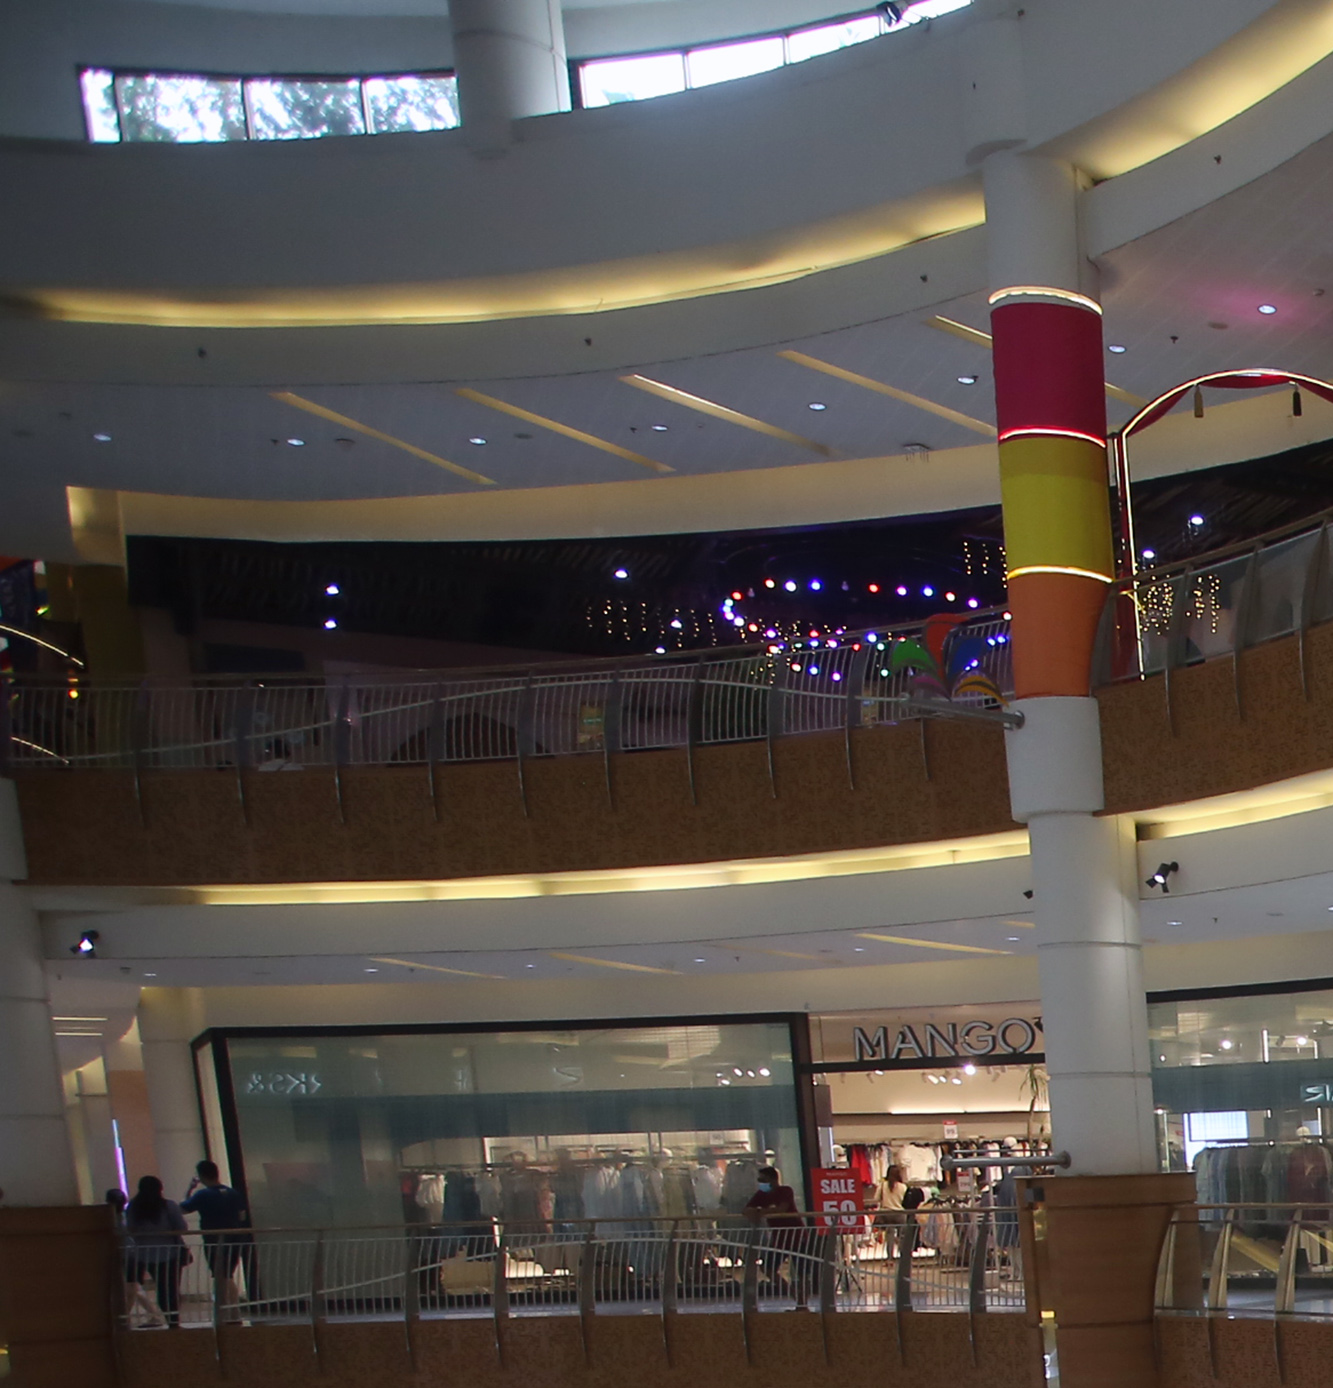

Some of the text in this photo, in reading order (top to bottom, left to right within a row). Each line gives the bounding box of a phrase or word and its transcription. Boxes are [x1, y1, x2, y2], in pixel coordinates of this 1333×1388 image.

[854, 1018, 1036, 1061] MANGO
[820, 1179, 856, 1194] SALE
[823, 1200, 857, 1226] 50
